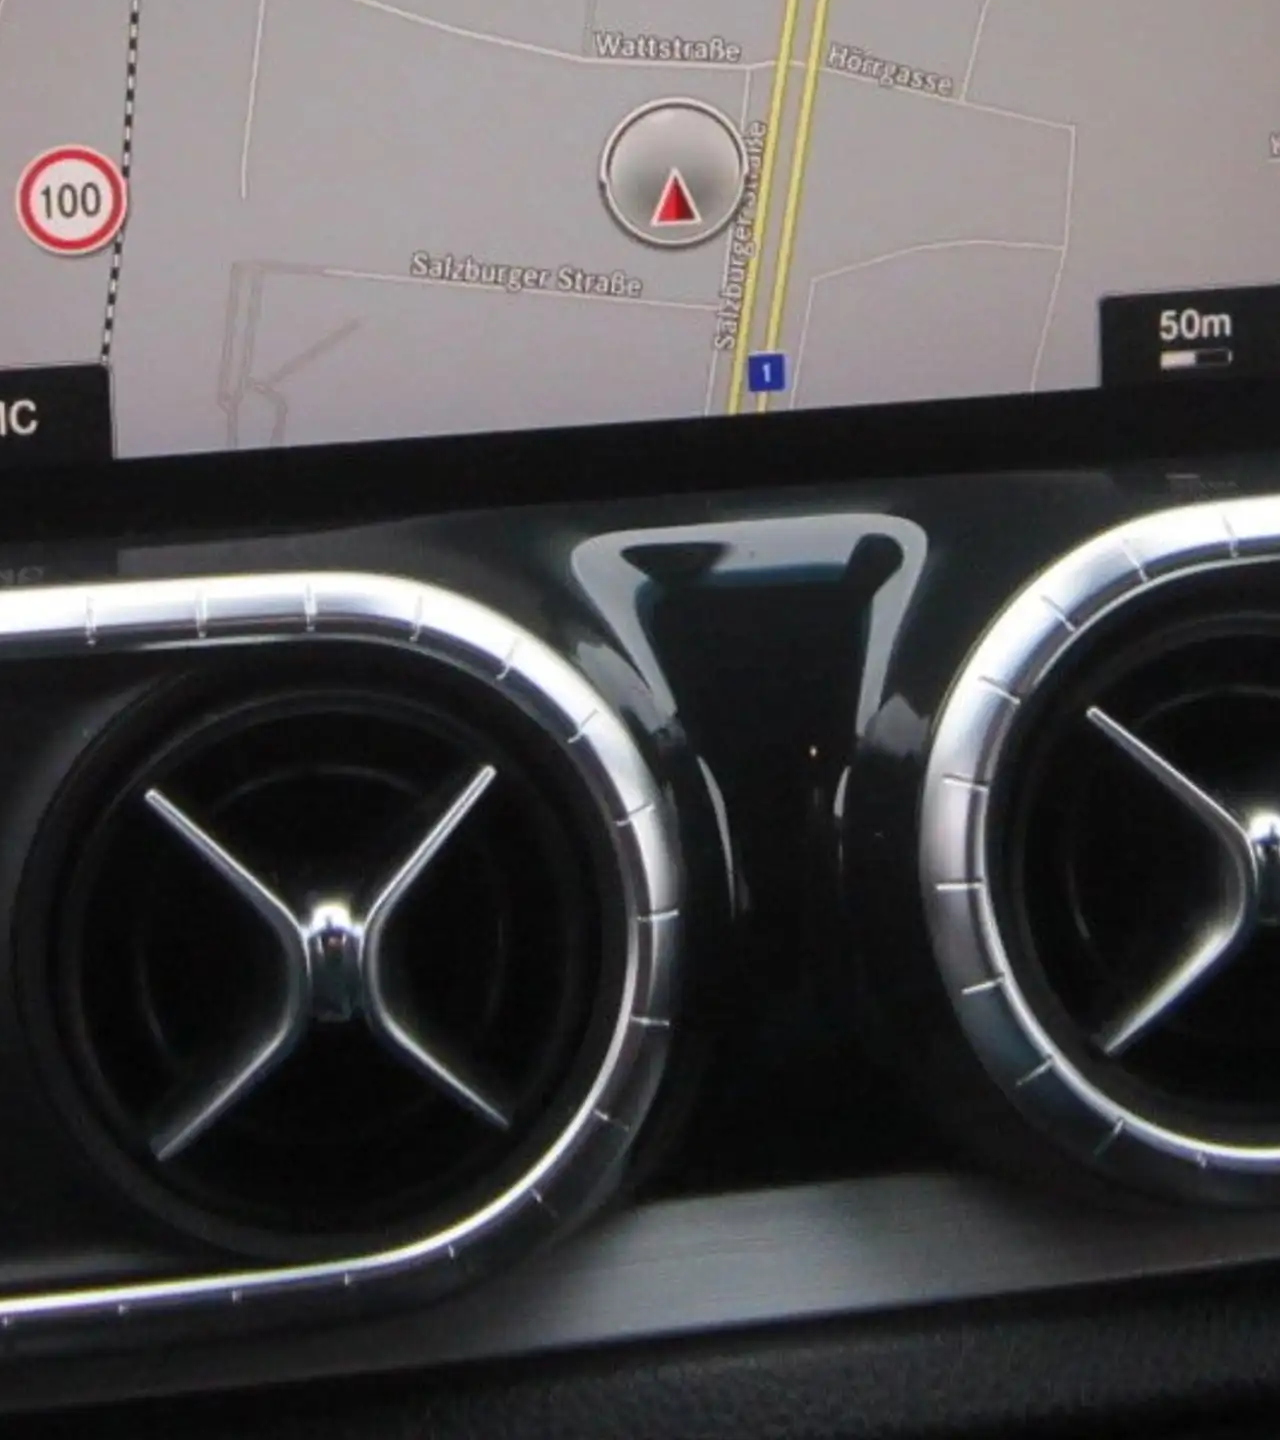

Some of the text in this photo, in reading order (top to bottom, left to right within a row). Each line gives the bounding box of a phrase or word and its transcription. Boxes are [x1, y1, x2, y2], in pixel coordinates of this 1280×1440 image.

[595, 32, 742, 63] Wattstraße
[828, 45, 954, 95] Hörrgasse
[40, 181, 102, 219] 100
[411, 250, 642, 298] Salzburger Straße
[715, 213, 759, 350] Salzburger
[1159, 307, 1232, 341] 50m
[761, 362, 772, 384] 1
